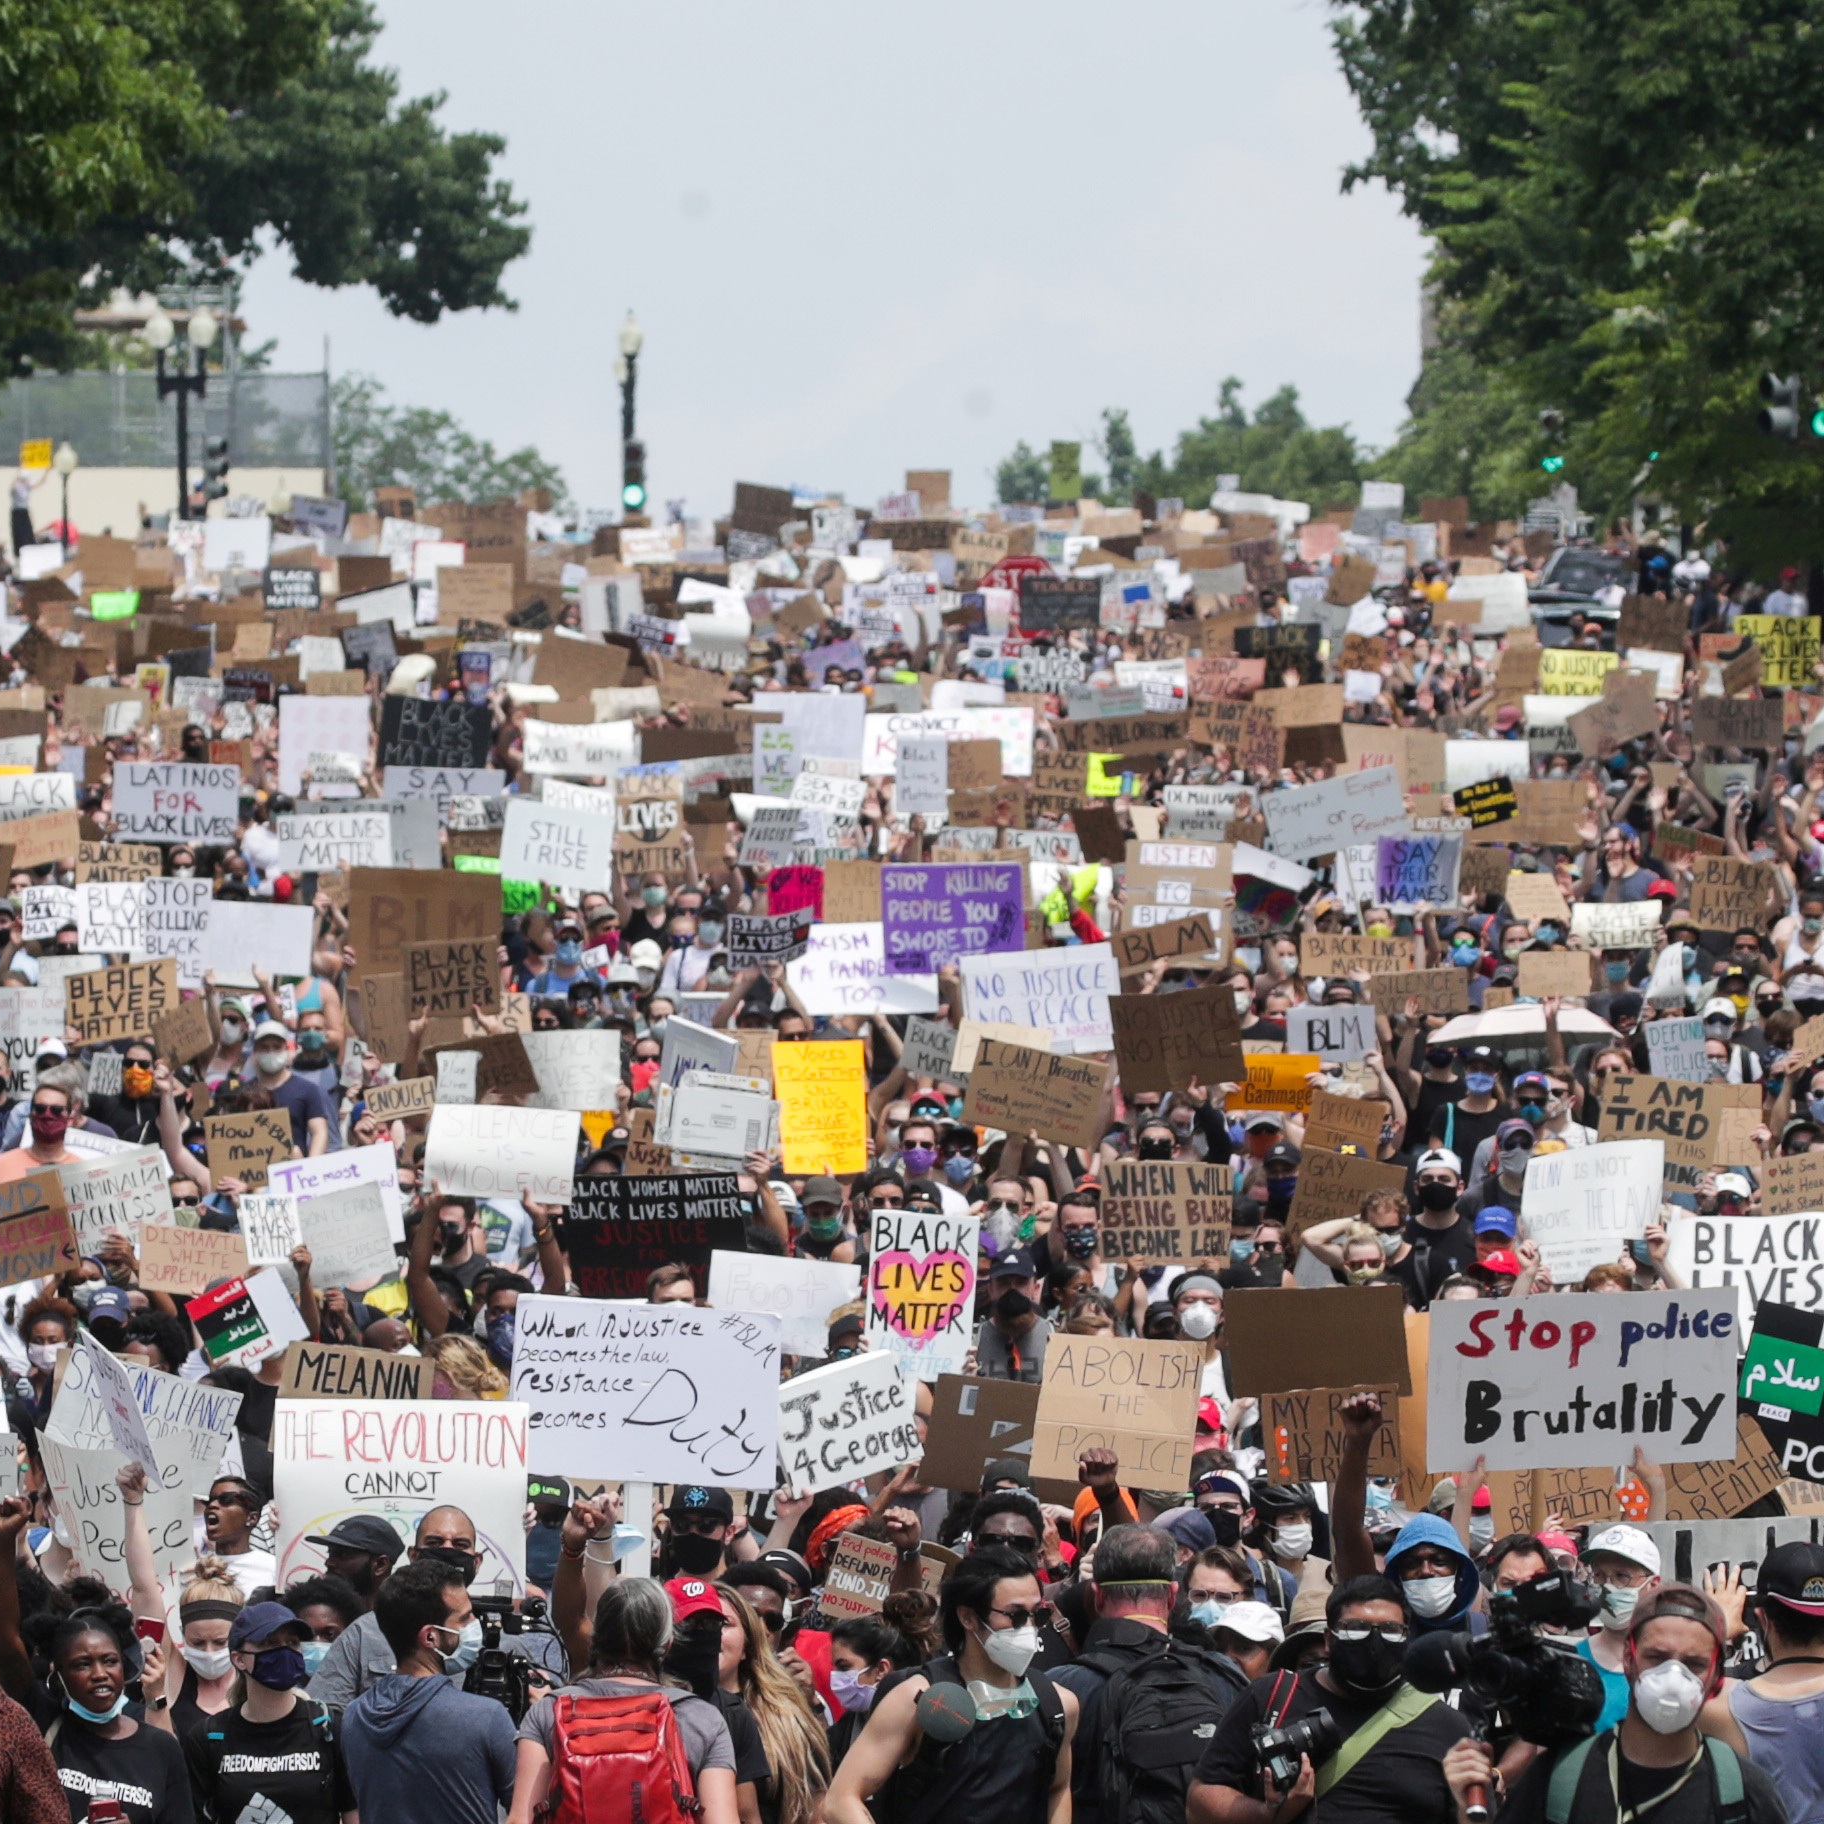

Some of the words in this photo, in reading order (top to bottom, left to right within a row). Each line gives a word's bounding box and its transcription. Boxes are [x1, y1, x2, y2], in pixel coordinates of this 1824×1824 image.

[129, 764, 236, 788] LATINOS
[154, 790, 202, 813] FOR
[116, 814, 176, 834] BLACK
[180, 816, 232, 837] LIVES
[1392, 839, 1444, 863] SAY
[885, 872, 929, 892] STOP
[946, 869, 1012, 896] KILLING
[1384, 862, 1438, 881] THEIR
[146, 879, 209, 906] STOP
[1380, 885, 1448, 903] NAMES
[145, 909, 208, 932] KILLING
[888, 899, 954, 922] PEOPLE
[964, 901, 1000, 923] YOU
[146, 934, 200, 956] BLACK
[891, 928, 957, 951] SWORE
[960, 926, 986, 947] TO
[1122, 921, 1214, 966] BLM
[1307, 1016, 1364, 1052] BLM
[368, 1082, 435, 1113] ENOUGH
[1105, 1166, 1176, 1197] WHEN
[1187, 1166, 1232, 1195] WILL
[1102, 1200, 1174, 1228] BEING
[1185, 1200, 1231, 1228] BLACK
[876, 1217, 972, 1255] BLACK
[1104, 1231, 1182, 1258] BECOME
[873, 1262, 965, 1292] LIVES
[870, 1304, 964, 1334] MATTER
[521, 1312, 592, 1339] When
[597, 1307, 705, 1338] injustice
[720, 1316, 777, 1370] #BLM
[1456, 1308, 1597, 1368] Stop
[1619, 1300, 1733, 1368] police
[295, 1350, 422, 1400] MELANIN
[516, 1368, 634, 1394] resistance
[1052, 1345, 1202, 1390] ABOLISH
[1745, 1359, 1822, 1397] سلام
[1098, 1395, 1146, 1416] THE
[1464, 1377, 1725, 1445] Brutality
[1761, 1408, 1791, 1420] PEACE
[527, 1408, 607, 1430] ecomes
[622, 1368, 766, 1478] Duty
[279, 1411, 336, 1461] THE
[344, 1412, 526, 1467] REVOLUTION
[792, 1450, 817, 1484] 4
[821, 1423, 921, 1472] George
[346, 1473, 442, 1495] CANNOT
